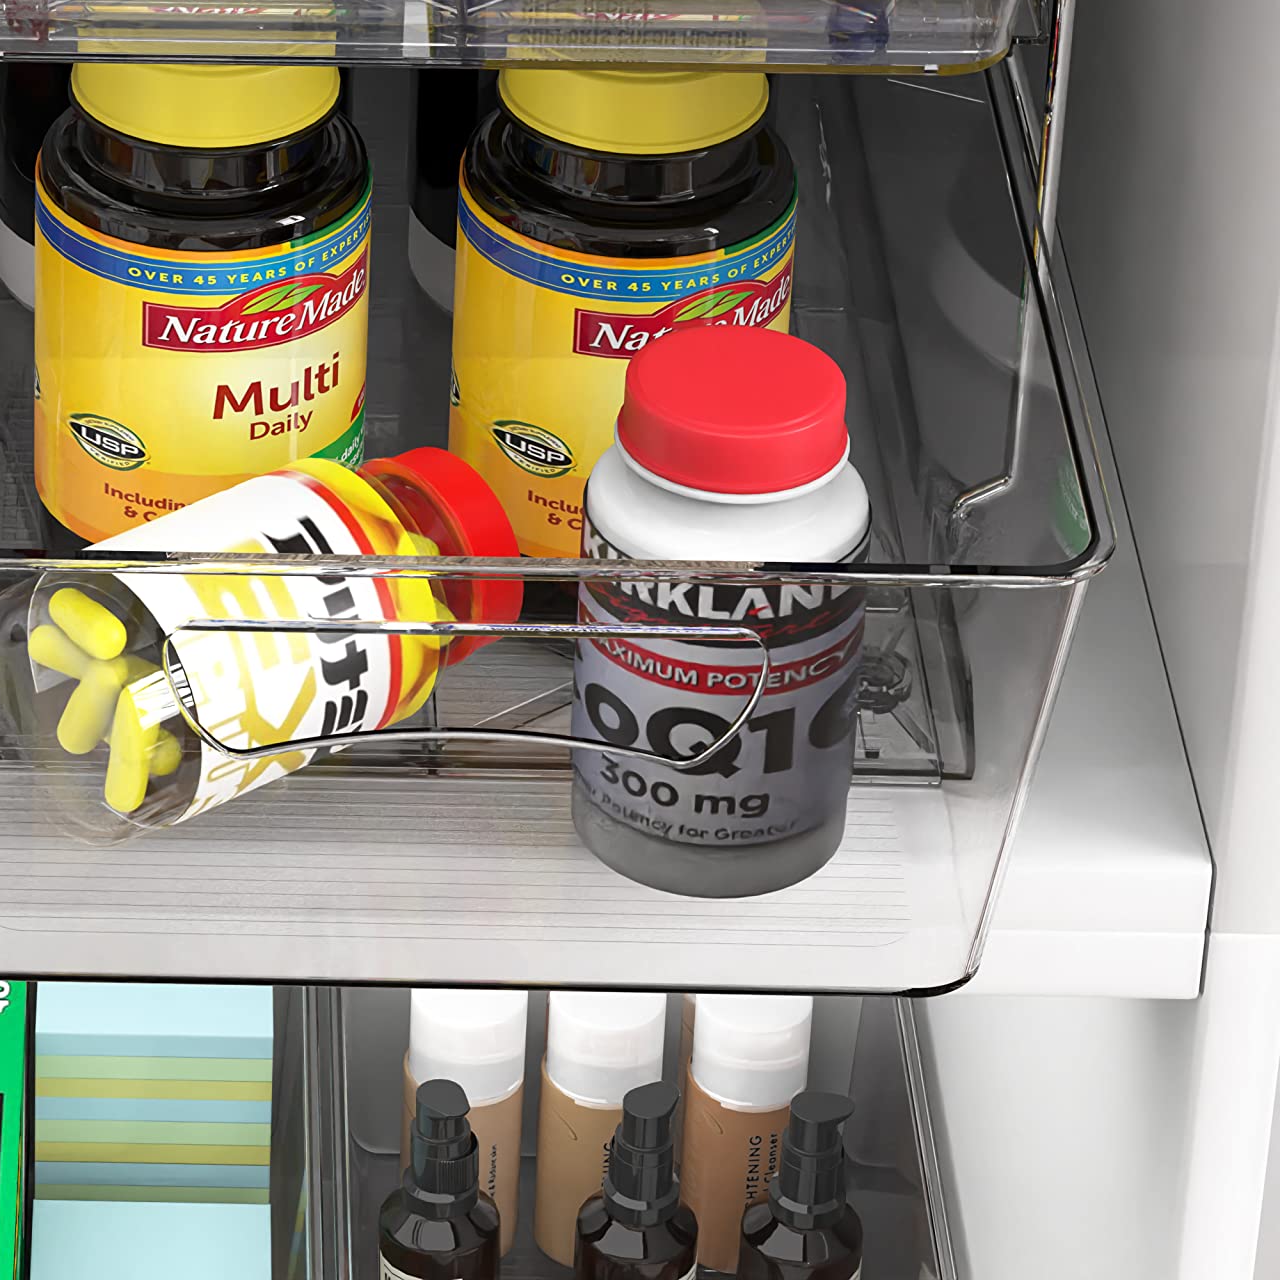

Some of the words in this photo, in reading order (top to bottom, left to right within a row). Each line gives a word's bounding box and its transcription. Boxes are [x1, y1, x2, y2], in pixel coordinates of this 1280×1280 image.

[127, 266, 183, 284] OVER
[193, 274, 217, 285] 45
[227, 267, 287, 284] YEARS
[294, 257, 316, 272] OF
[560, 274, 618, 291] OVER
[628, 282, 651, 292] 45
[660, 274, 720, 291] YEARS
[727, 264, 748, 279] OF
[157, 308, 296, 344] Nature
[212, 351, 340, 420] Multi
[81, 425, 140, 456] USP
[249, 409, 313, 441] Daily
[600, 751, 679, 807] 300
[694, 792, 770, 819] mg
[745, 1134, 762, 1208] HTENING
